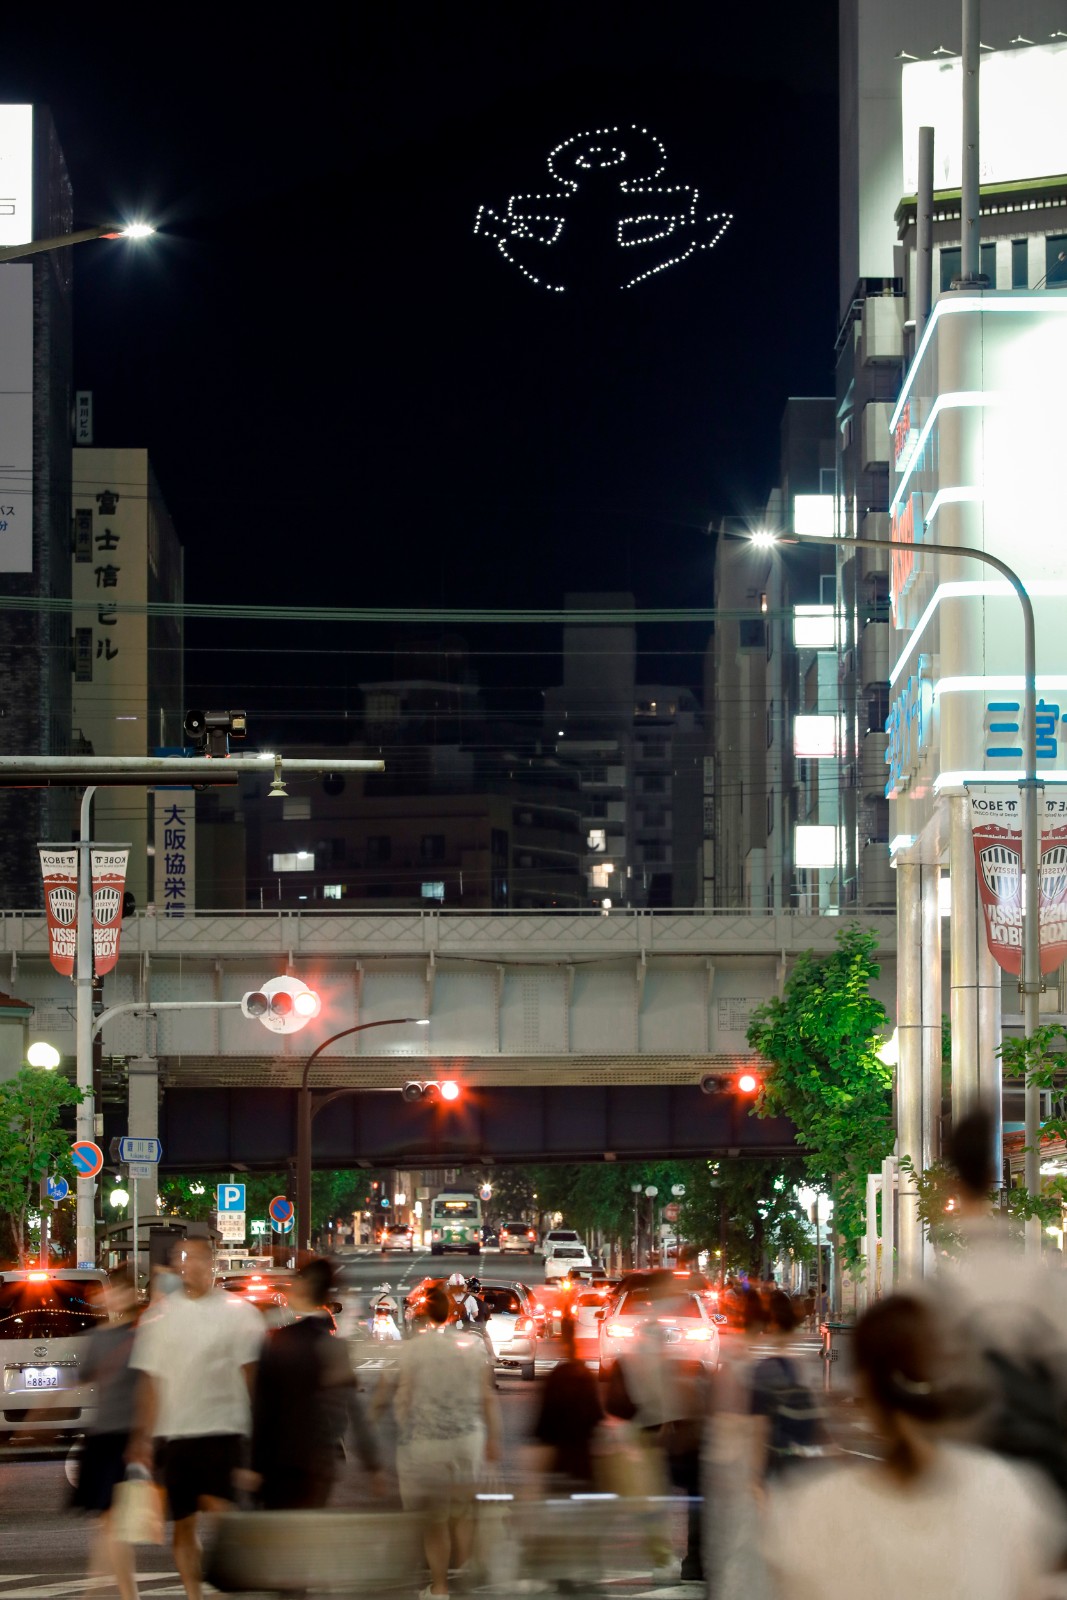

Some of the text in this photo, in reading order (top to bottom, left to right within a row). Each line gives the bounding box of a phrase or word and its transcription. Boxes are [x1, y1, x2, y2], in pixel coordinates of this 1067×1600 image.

[94, 490, 120, 661] 富士信ビル
[986, 698, 1067, 758] 三宮
[972, 799, 1003, 811] KOBE
[43, 856, 65, 864] KOBE
[993, 866, 1018, 875] VISSEL
[224, 1186, 241, 1209] P
[32, 1377, 57, 1387] 88-32
